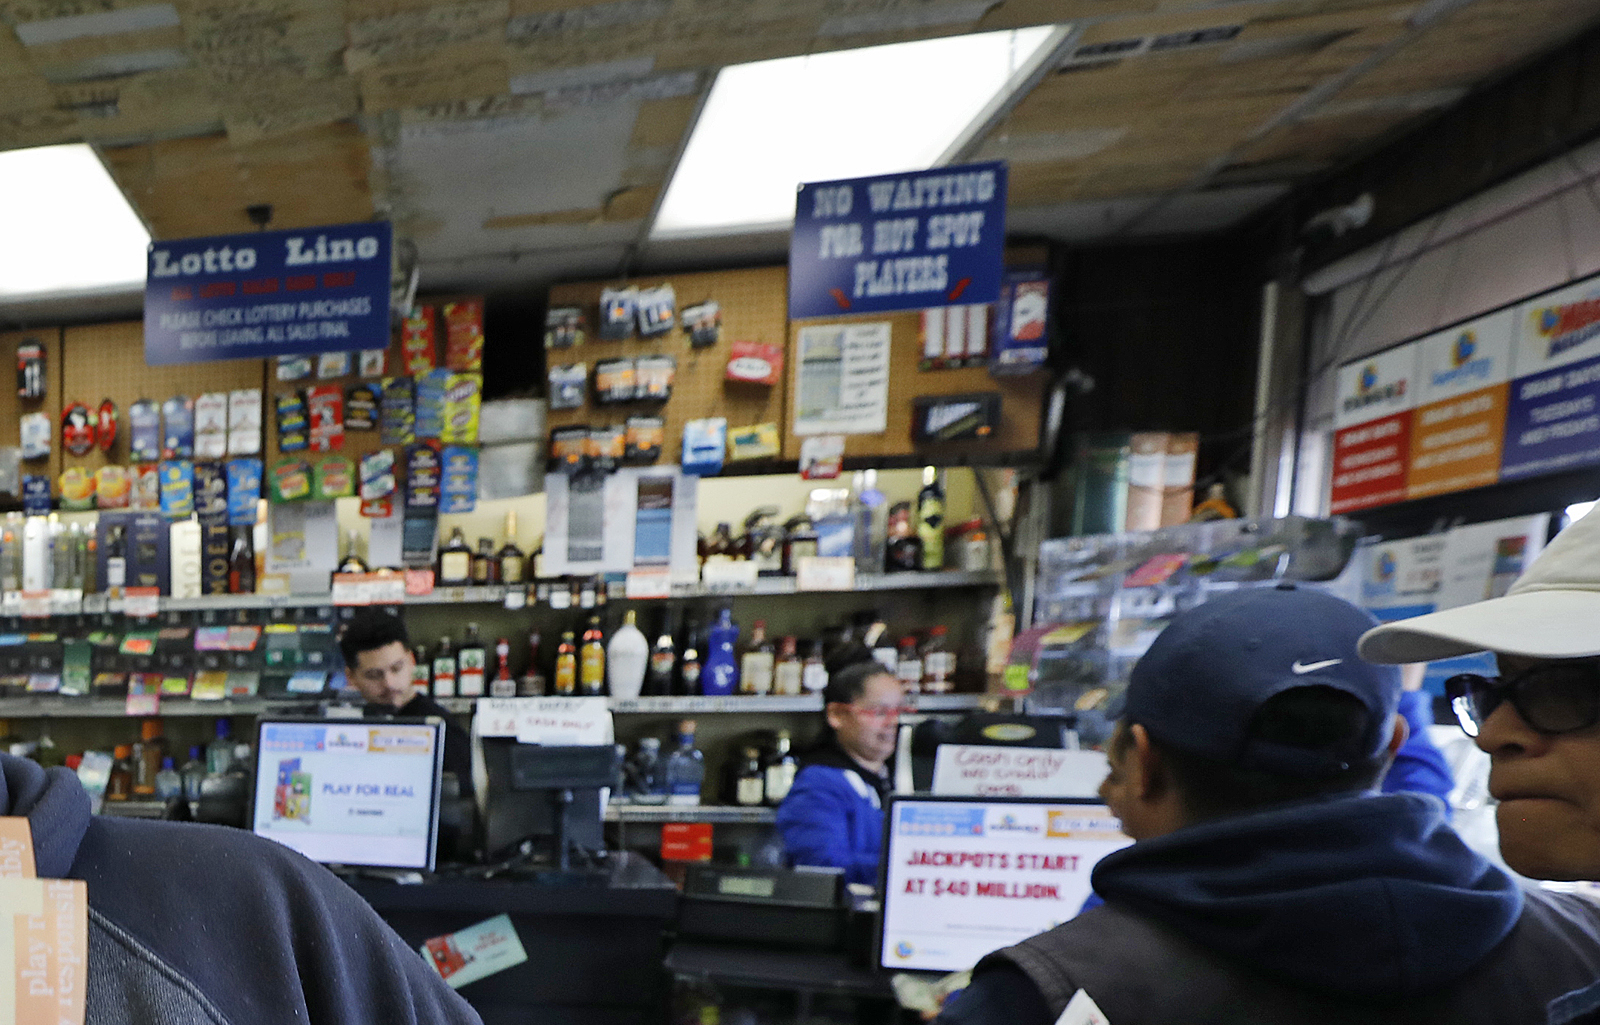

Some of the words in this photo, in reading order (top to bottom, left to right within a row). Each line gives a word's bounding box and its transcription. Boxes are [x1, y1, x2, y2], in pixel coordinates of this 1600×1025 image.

[811, 185, 854, 219] NO
[868, 169, 996, 213] WAITING
[152, 246, 257, 278] Lotto
[285, 235, 378, 267] Line
[818, 222, 864, 260] FOR
[926, 210, 985, 249] SPOT
[853, 254, 949, 298] PLAYERS
[203, 308, 242, 326] CHECK
[244, 302, 296, 324] LOTTERY
[298, 296, 372, 320] PURCHASES
[323, 783, 351, 795] PLAY
[356, 784, 381, 796] FOR
[384, 785, 414, 798] REAL
[907, 851, 1009, 869] JACKPOTS
[1017, 854, 1080, 873] START
[905, 879, 926, 893] AT
[933, 879, 970, 896] $40
[21, 936, 54, 996] play
